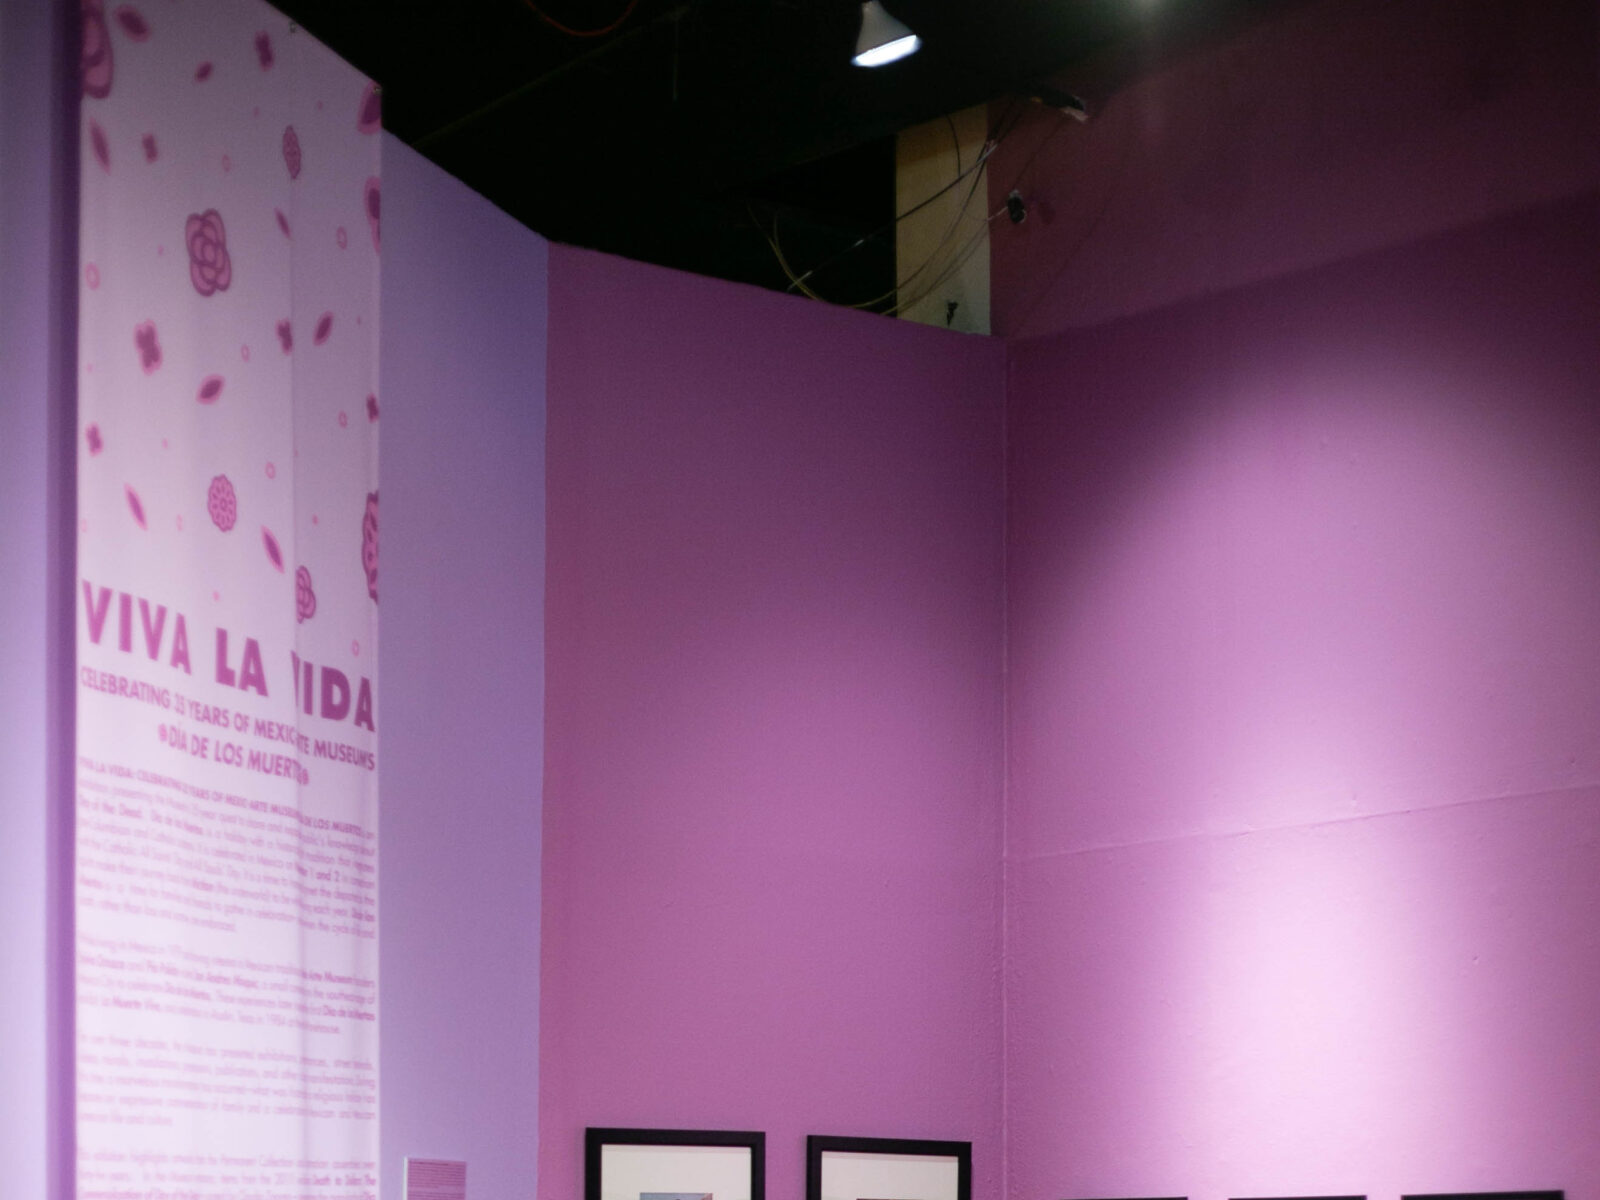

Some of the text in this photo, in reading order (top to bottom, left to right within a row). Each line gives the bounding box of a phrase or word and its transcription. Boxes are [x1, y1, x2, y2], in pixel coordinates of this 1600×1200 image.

[82, 579, 192, 676] VIVA
[214, 626, 269, 698] LA
[80, 665, 171, 710] CELEBRATING
[187, 699, 231, 728] YEARS
[233, 711, 250, 735] OF
[190, 733, 209, 760] DE
[214, 738, 244, 768] LOS
